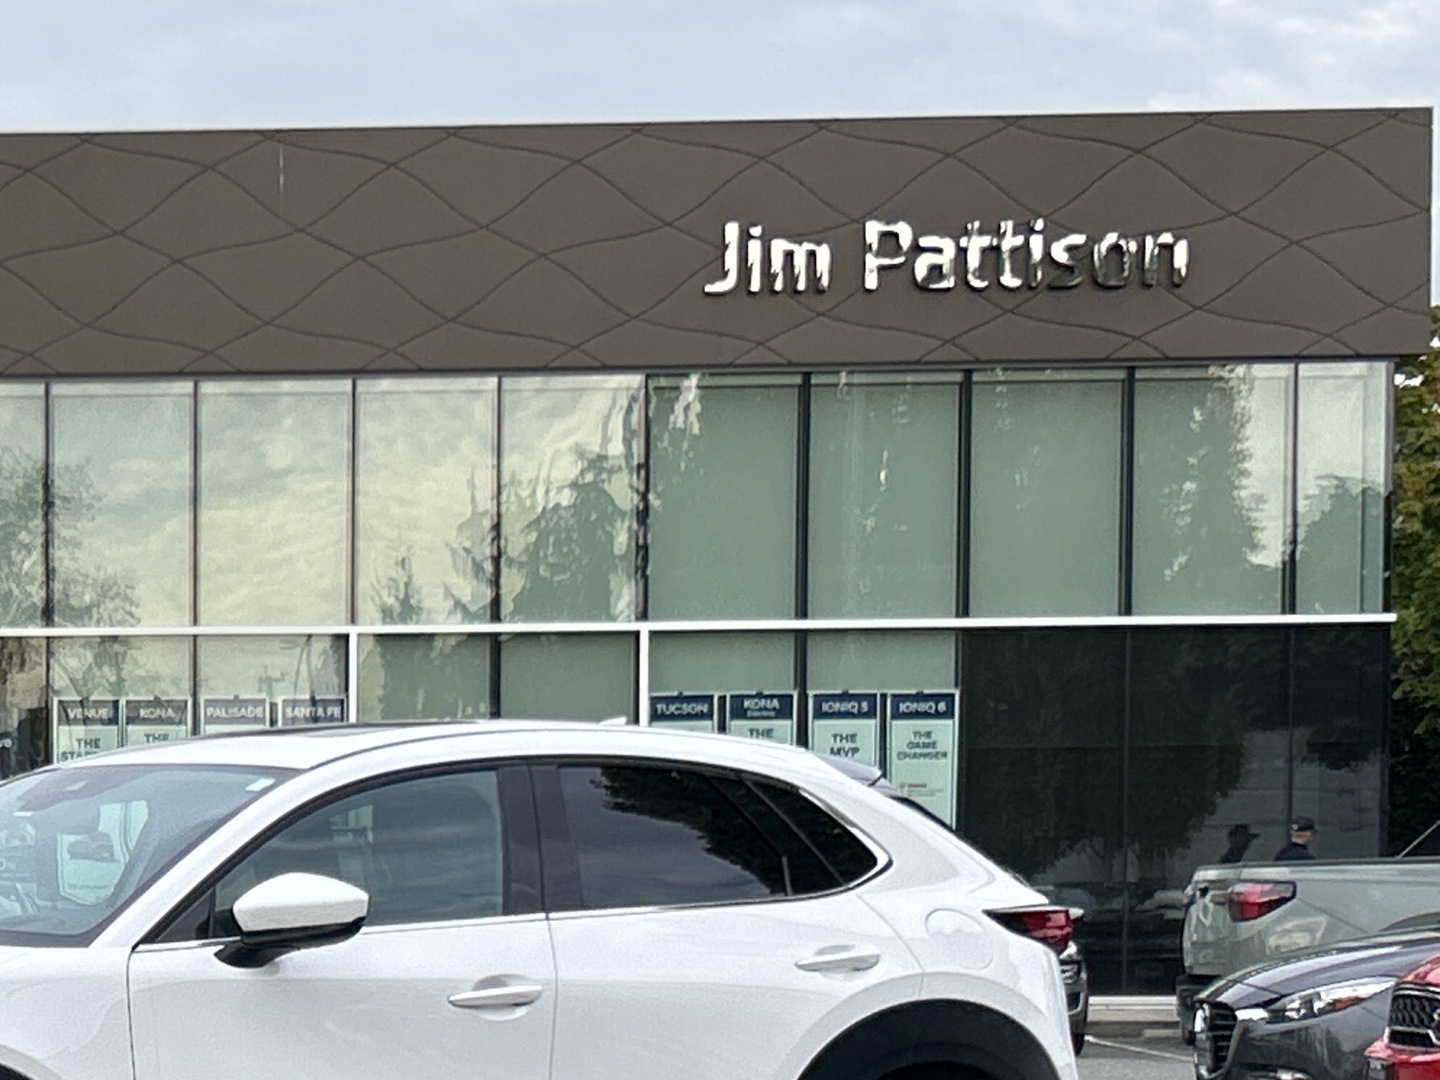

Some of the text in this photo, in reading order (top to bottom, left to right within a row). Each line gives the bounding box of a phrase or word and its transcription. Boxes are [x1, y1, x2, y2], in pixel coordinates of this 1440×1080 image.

[704, 217, 1192, 295] Jim Pattison
[656, 703, 709, 715] TUCSON
[743, 698, 780, 710] KONA
[821, 701, 869, 715] IONIQ 5
[899, 701, 947, 715] IONIQ 6
[67, 707, 109, 719] VENUS
[140, 707, 176, 719] KONA
[205, 706, 264, 718] PALISADE
[285, 706, 342, 718] SANTA FE
[144, 733, 169, 744] THE
[747, 728, 774, 739] THE
[831, 733, 858, 744] THE
[912, 731, 933, 740] THE
[75, 738, 101, 749] THE
[906, 741, 938, 750] GAME
[829, 746, 860, 758] MVP
[896, 751, 949, 760] CHANGER
